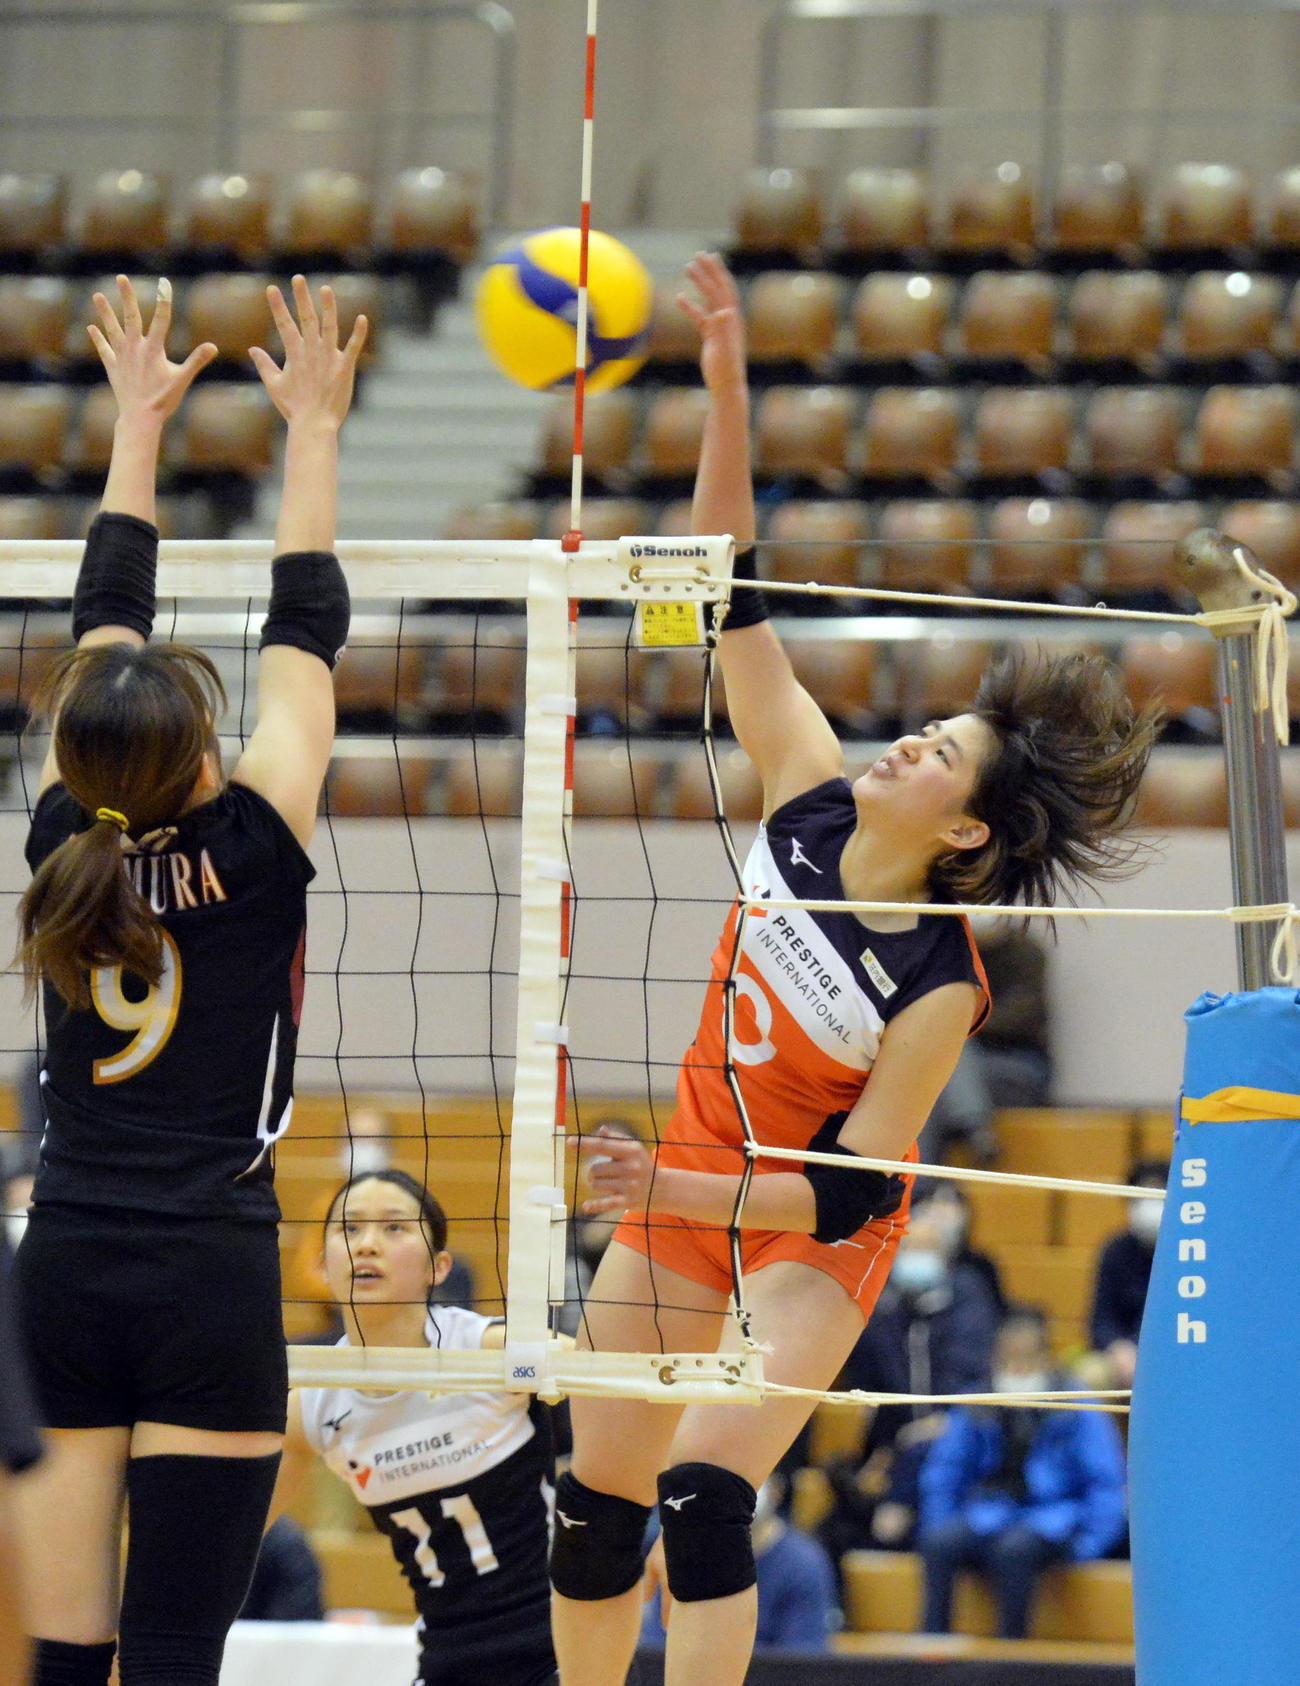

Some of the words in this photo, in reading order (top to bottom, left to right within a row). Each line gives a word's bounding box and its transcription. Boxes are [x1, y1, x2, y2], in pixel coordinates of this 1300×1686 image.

[643, 545, 708, 557] Senoh
[756, 928, 850, 1045] INTERNATIONAL
[772, 915, 842, 1001] PRESTIGE
[90, 922, 183, 1085] 9
[512, 1366, 536, 1378] asics
[373, 1432, 454, 1467] PRESTIGE
[379, 1439, 491, 1484] INTERNATIONAL
[389, 1493, 500, 1588] 11
